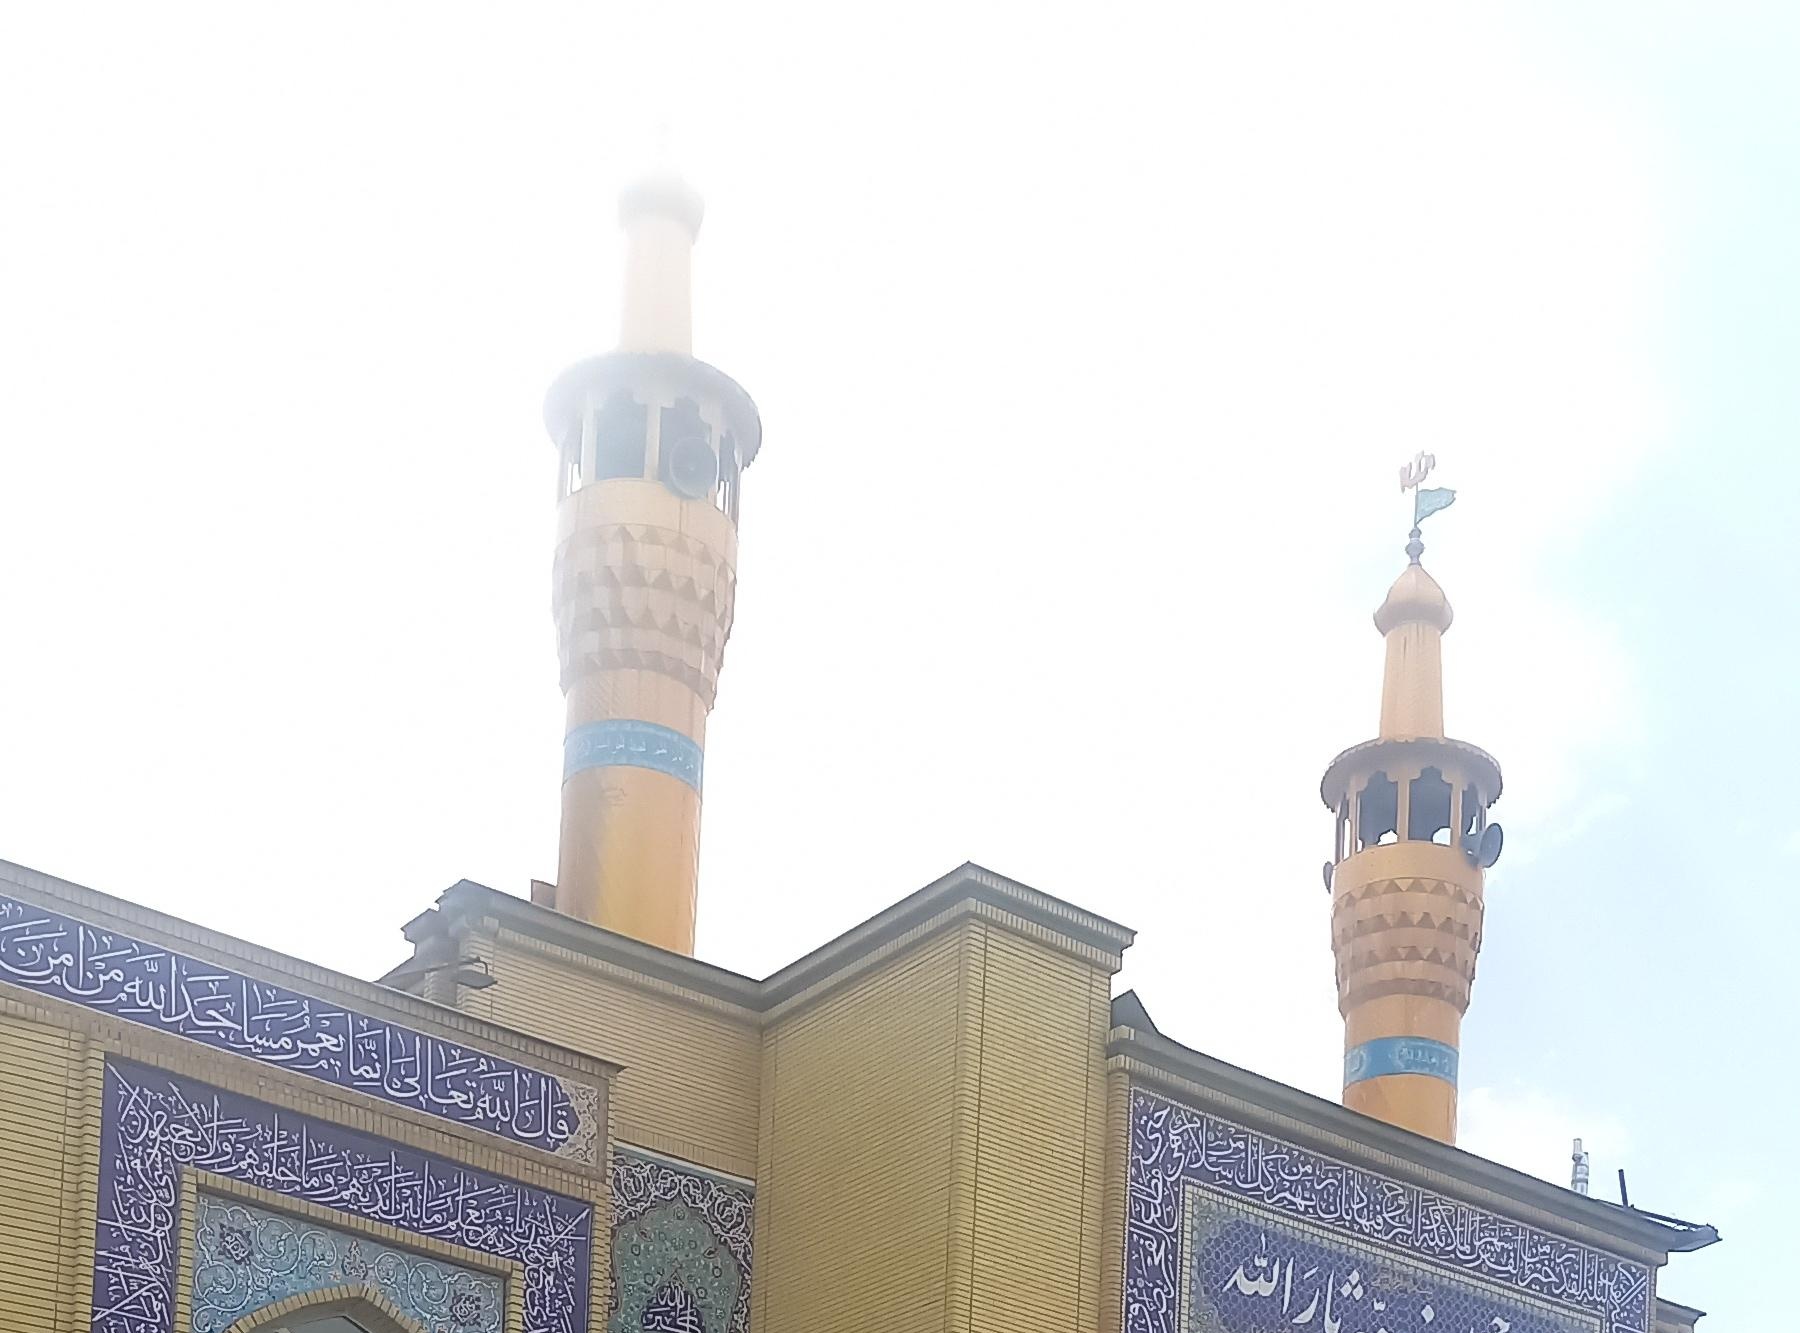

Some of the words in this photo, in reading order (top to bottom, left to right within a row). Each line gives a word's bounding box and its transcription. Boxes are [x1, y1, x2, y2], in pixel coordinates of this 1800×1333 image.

[478, 1066, 520, 1124] الله
[512, 1072, 571, 1140] قال
[1221, 1232, 1296, 1314] الله
